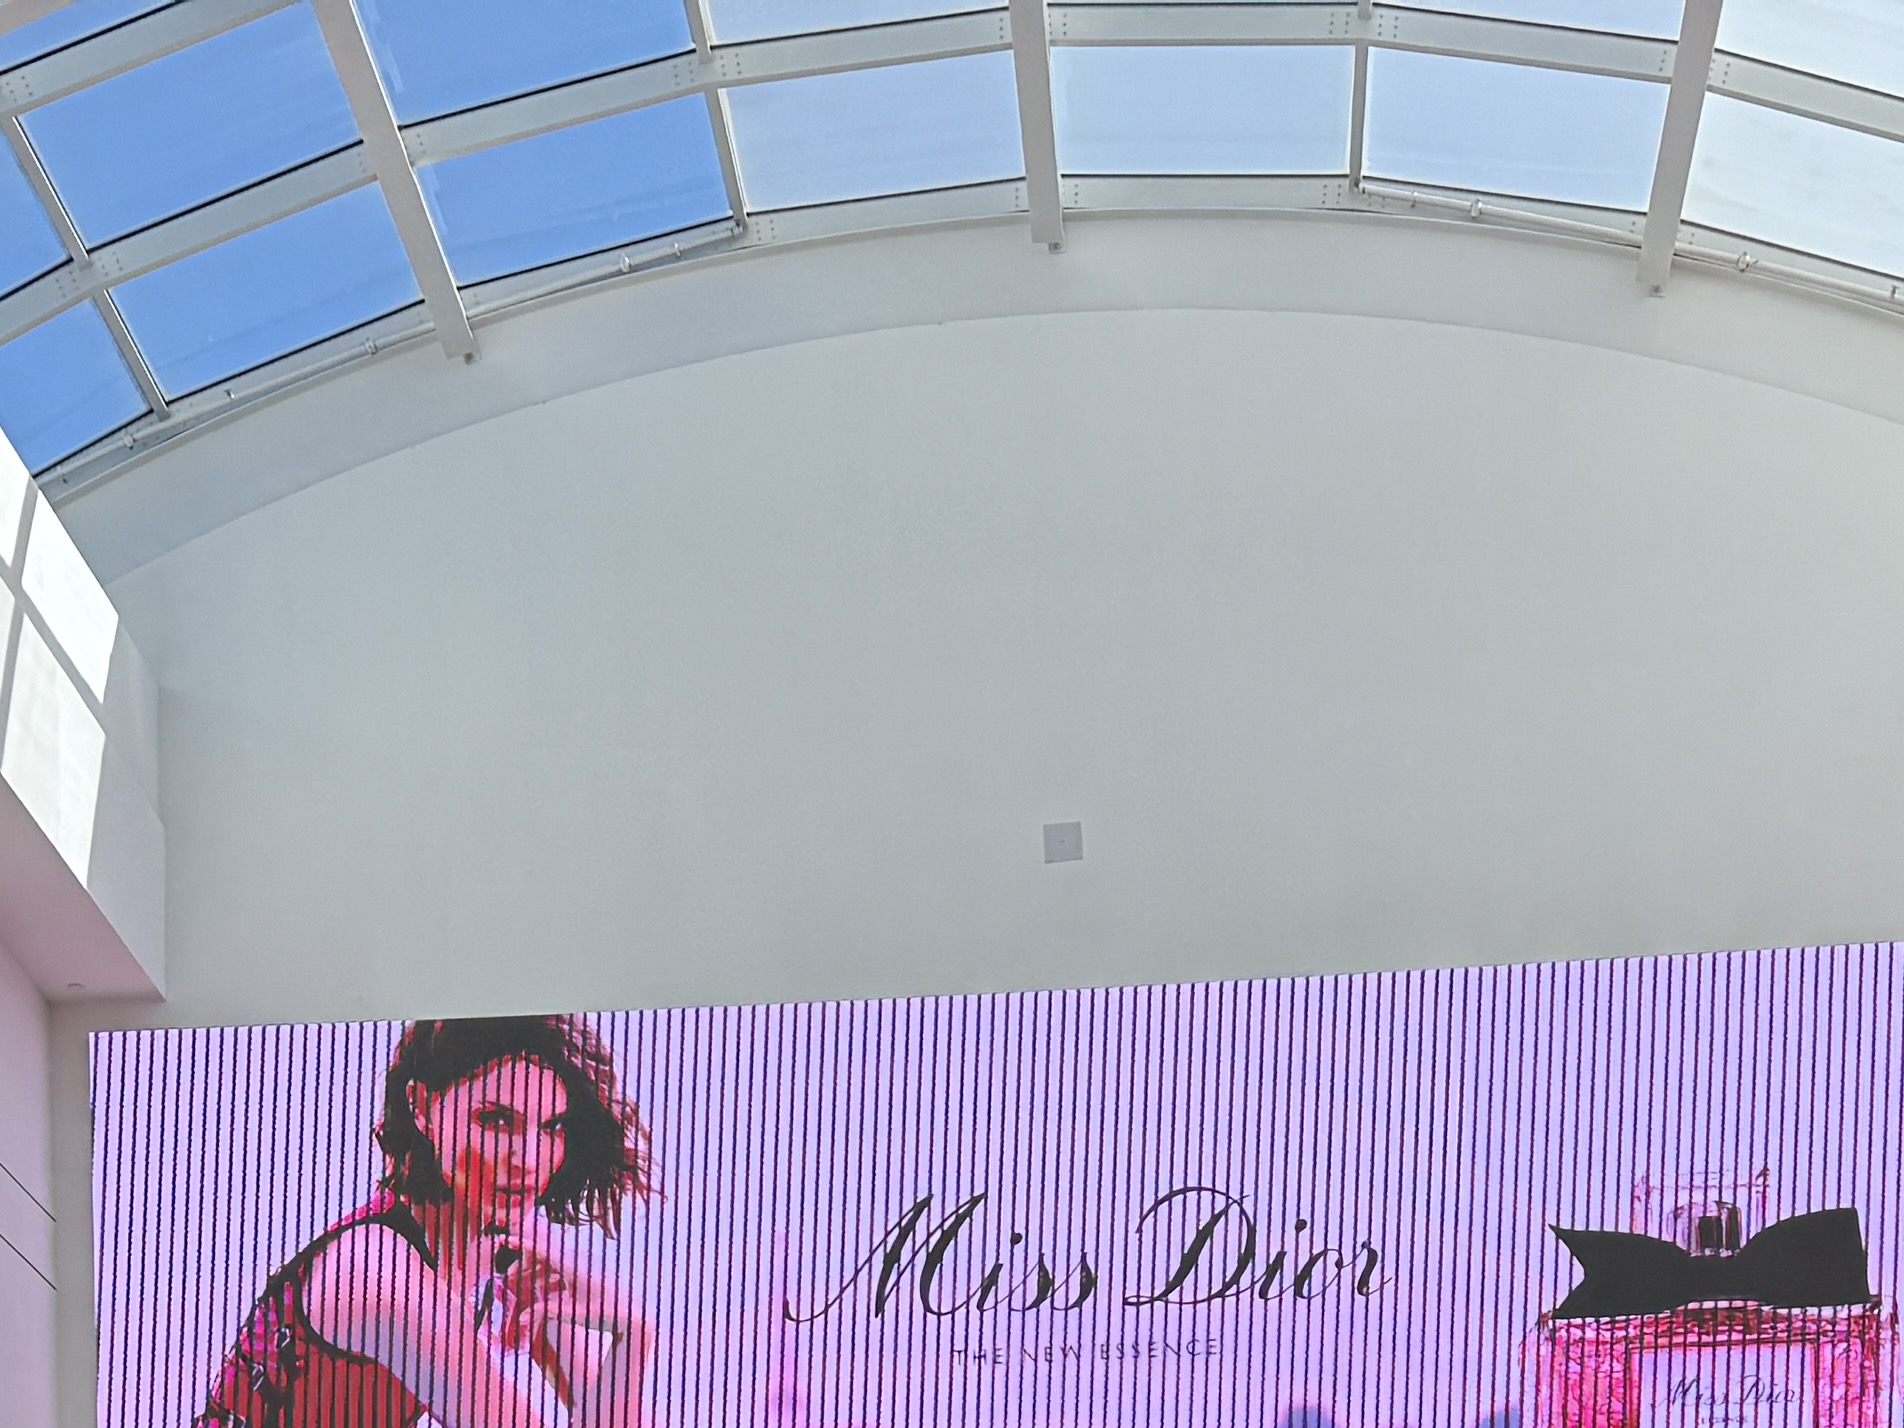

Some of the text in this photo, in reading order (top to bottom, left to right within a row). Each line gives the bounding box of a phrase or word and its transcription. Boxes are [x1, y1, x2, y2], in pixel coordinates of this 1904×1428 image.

[784, 1186, 1394, 1322] Miss Dior
[953, 1338, 1217, 1366] THE NEW ESSENCE
